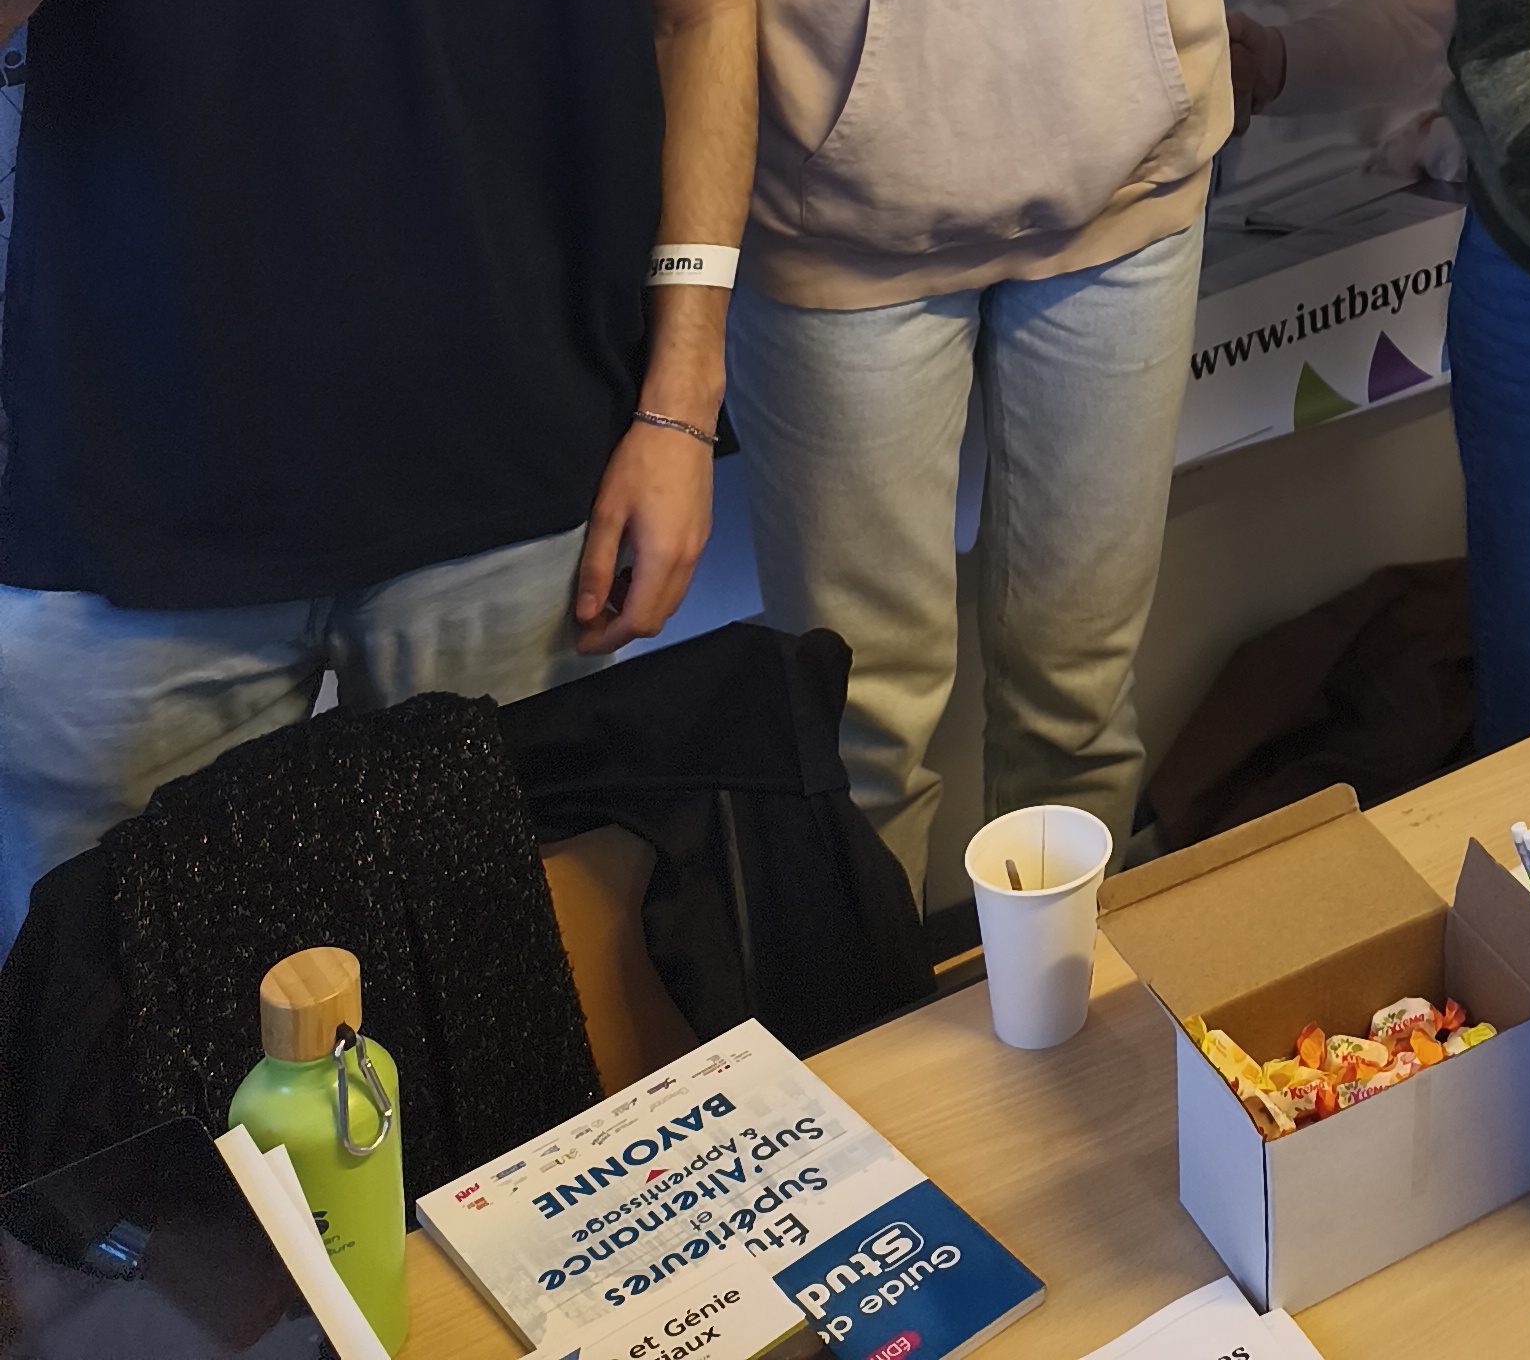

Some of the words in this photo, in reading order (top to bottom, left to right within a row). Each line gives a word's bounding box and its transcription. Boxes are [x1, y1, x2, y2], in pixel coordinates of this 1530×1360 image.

[532, 1092, 737, 1221] BAYONNE
[571, 1136, 738, 1243] Apprentissage
[604, 1167, 829, 1308] Supérieures
[859, 1244, 963, 1316] Guide
[663, 1289, 741, 1338] Génie
